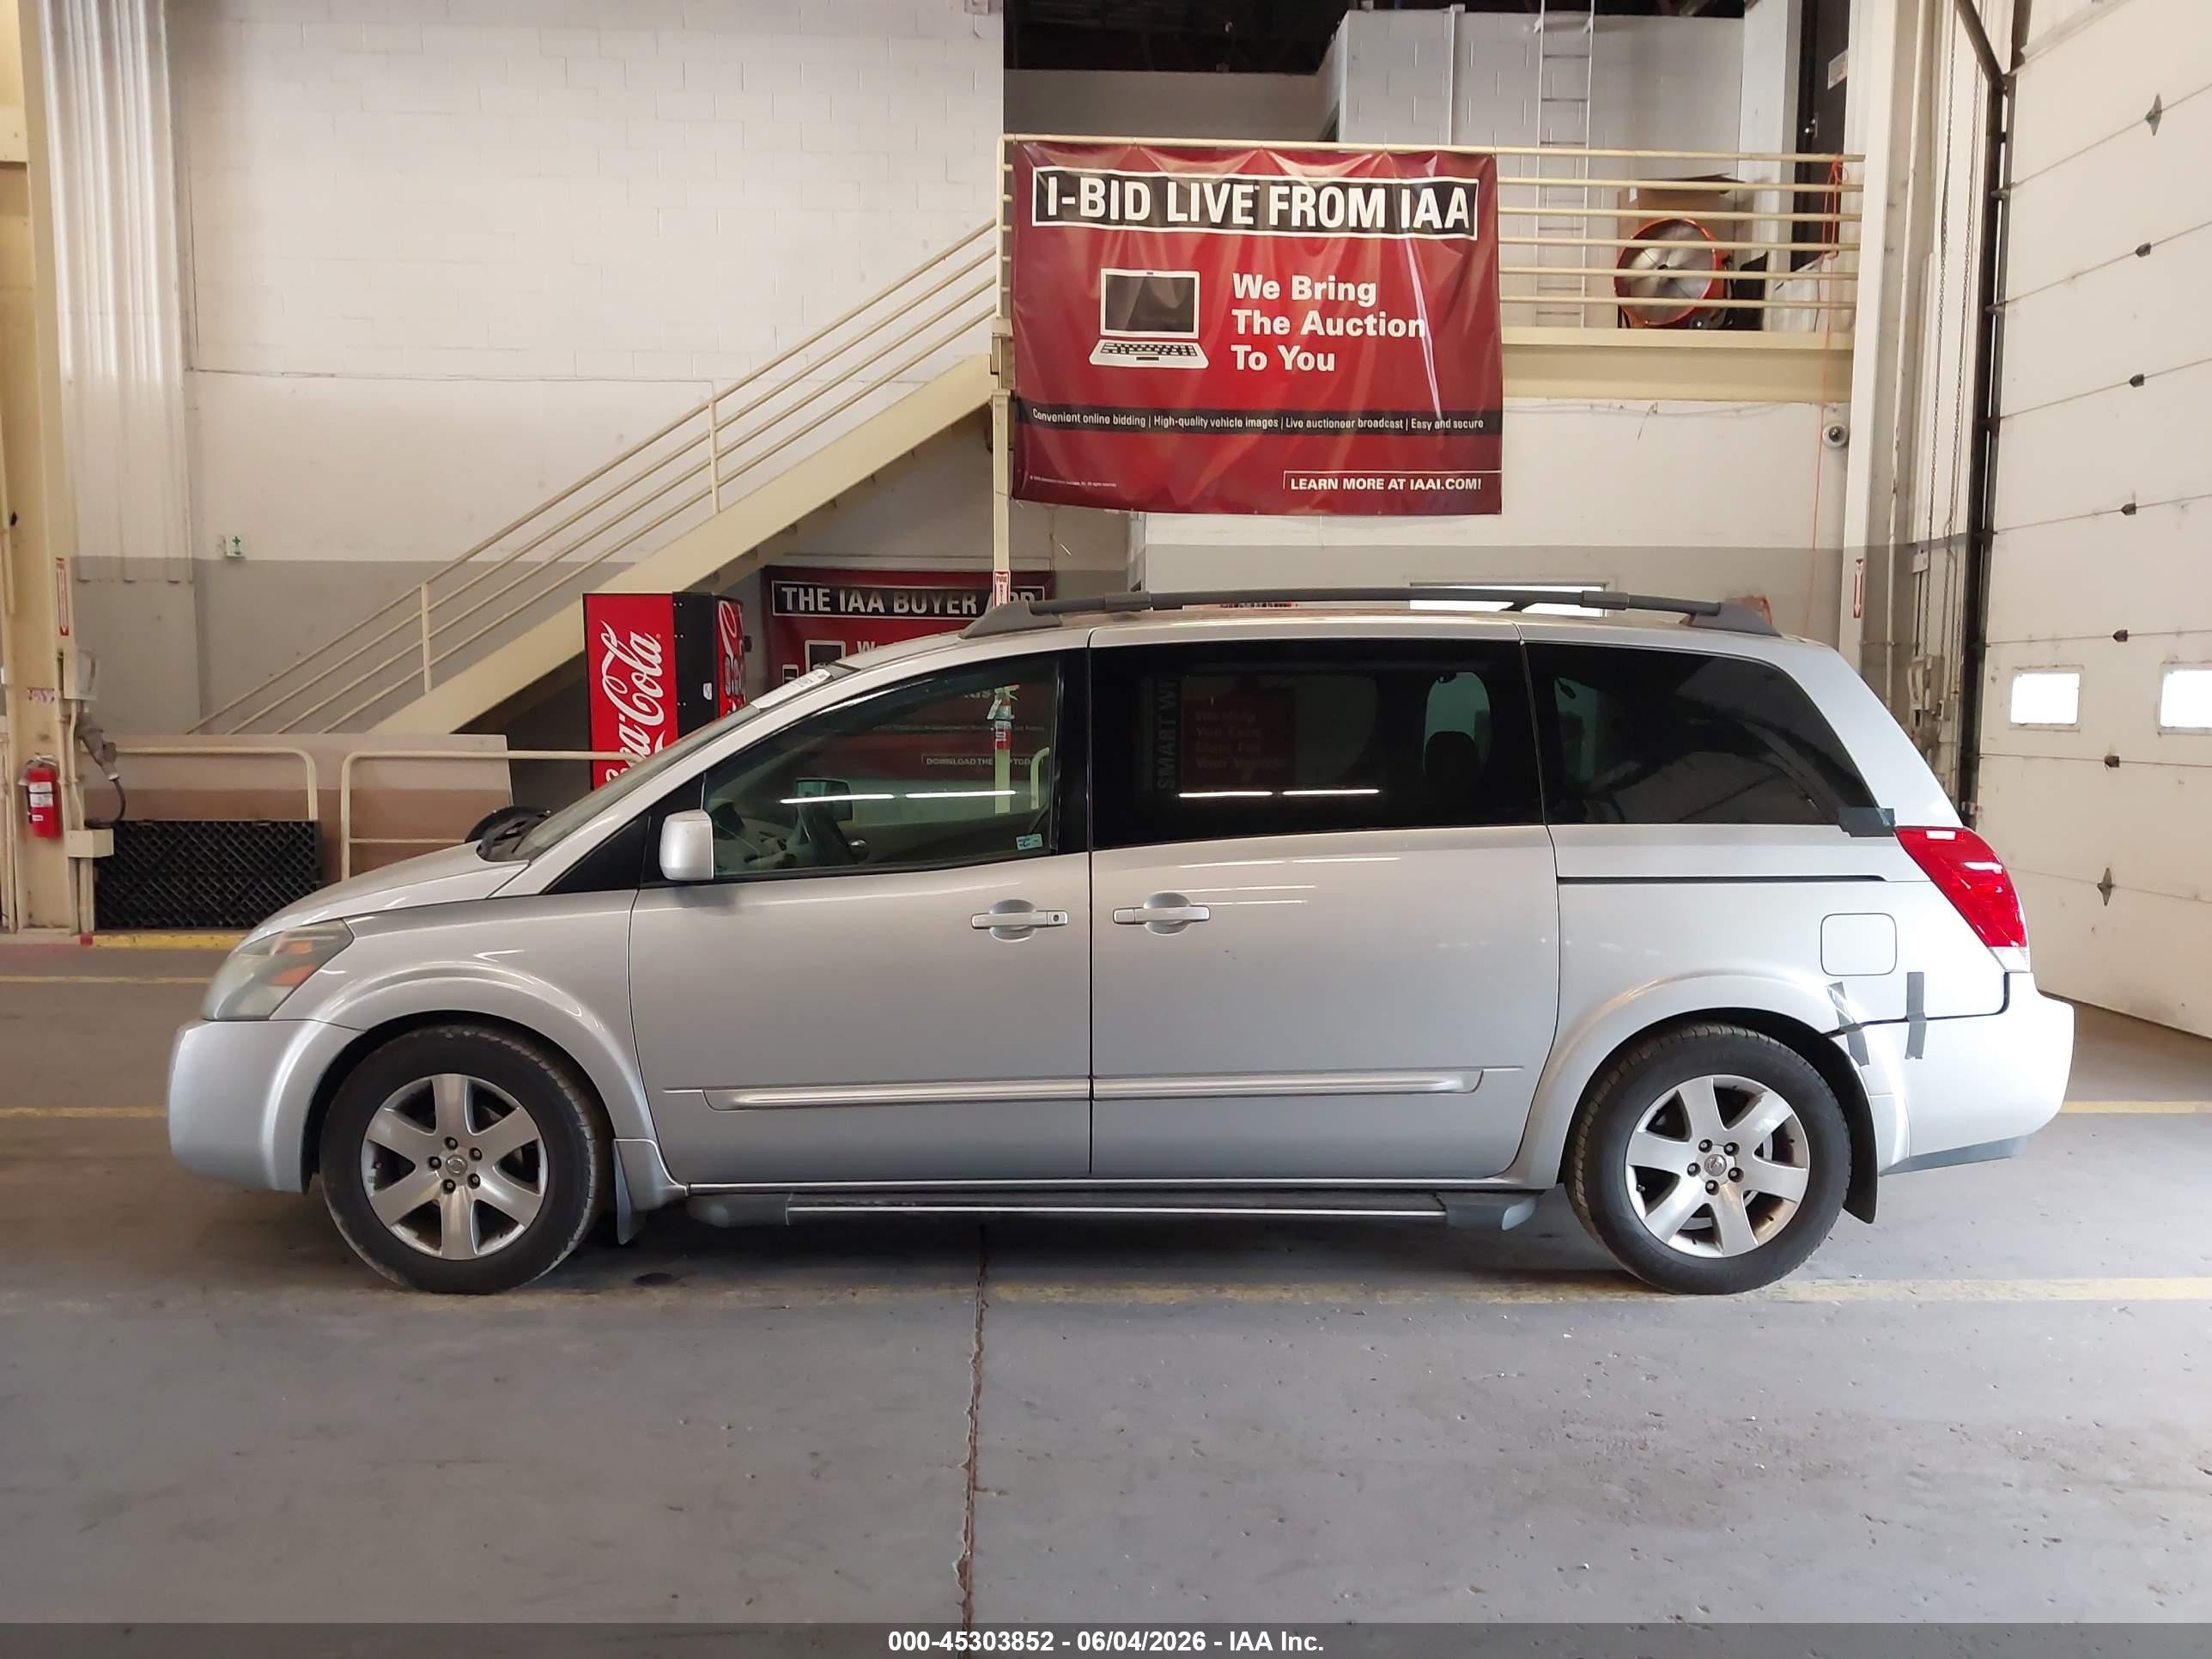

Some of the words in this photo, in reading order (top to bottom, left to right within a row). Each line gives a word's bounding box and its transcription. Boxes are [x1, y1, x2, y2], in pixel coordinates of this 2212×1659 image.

[1047, 175, 1152, 222] I-BID
[1166, 180, 1256, 226] LIVE
[1268, 184, 1386, 230] FROM
[1400, 186, 1470, 230] IAA
[1232, 272, 1280, 300] We
[1291, 274, 1376, 307] Bring
[1231, 308, 1291, 336] The
[1299, 310, 1426, 338] Auction
[1230, 343, 1268, 371] To
[1277, 343, 1336, 372] You
[1032, 407, 1081, 424] Convenient
[1082, 413, 1111, 425] online
[1112, 413, 1146, 428] bidding
[1153, 414, 1209, 430] High-quality
[1210, 415, 1244, 428] vehicle
[1244, 416, 1279, 430] images
[1285, 416, 1304, 429] Live
[1305, 416, 1356, 429] auctioneer
[1357, 416, 1404, 430] broadcast
[1411, 417, 1432, 431] Easy
[1434, 418, 1452, 430] and
[1452, 418, 1485, 429] secure
[1290, 477, 1340, 491] LEARN
[1342, 477, 1385, 491] MORE
[1387, 477, 1407, 490] AT
[1409, 477, 1482, 491] IAAI.COM!
[781, 586, 832, 613] THE
[838, 588, 886, 615] IAA
[892, 590, 977, 616] BUYER
